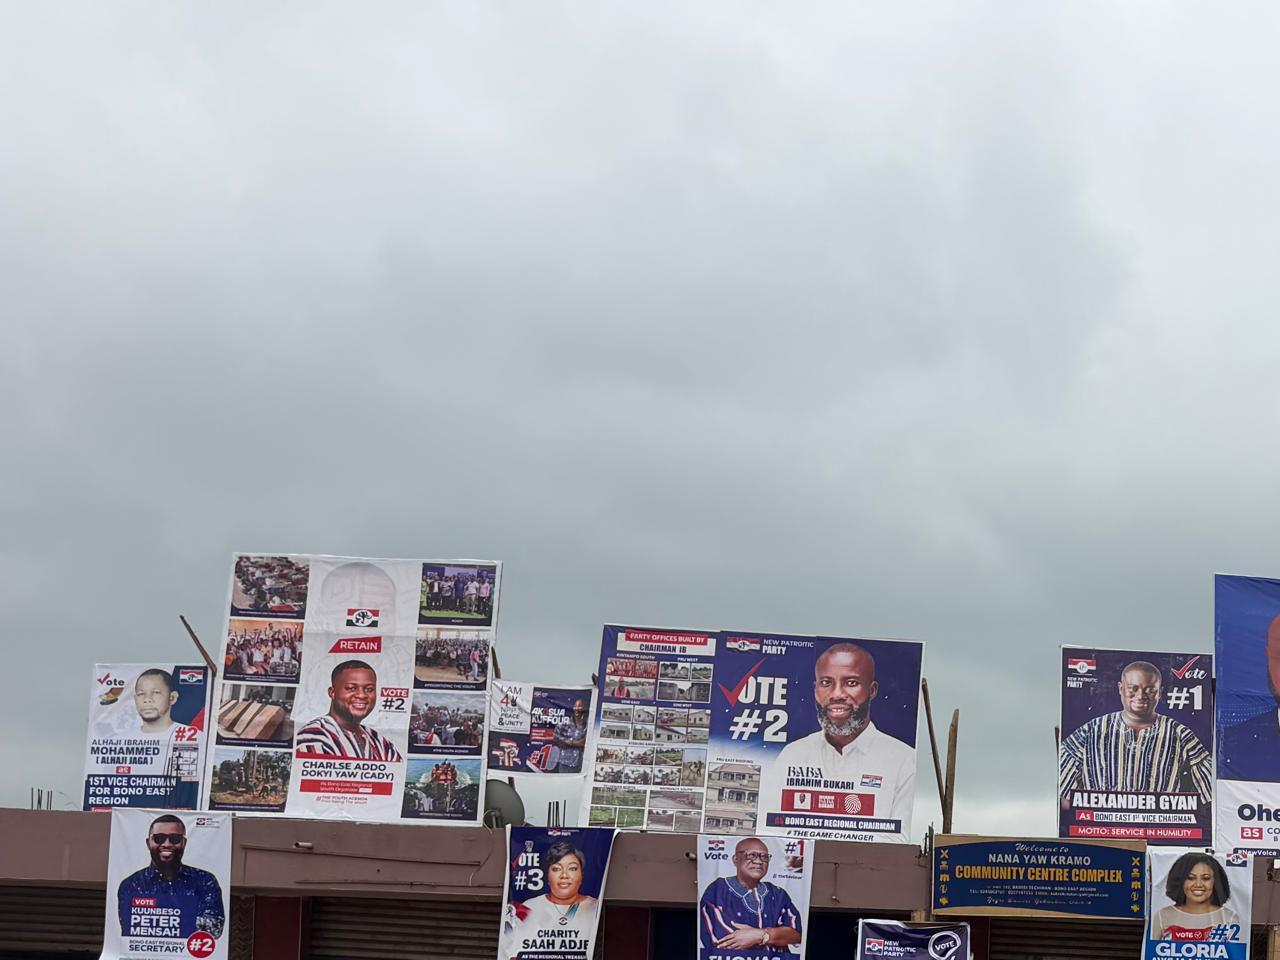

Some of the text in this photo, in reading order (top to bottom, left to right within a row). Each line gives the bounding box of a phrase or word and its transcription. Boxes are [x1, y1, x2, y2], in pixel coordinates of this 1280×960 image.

[340, 642, 377, 651] RETAIN
[639, 644, 676, 654] CHAIRMAN
[762, 646, 786, 655] PARTY
[382, 689, 408, 697] VOTE
[1167, 685, 1202, 710] #1
[382, 698, 406, 712] #2
[729, 709, 788, 743] #2
[175, 726, 198, 742] #2
[90, 747, 160, 756] MOHAMMED
[354, 763, 386, 773] ADDO
[788, 766, 823, 778] BABA
[301, 770, 358, 780] DOKYI YAW
[107, 777, 176, 787] VICE CHAIRMAN
[786, 778, 854, 790] IBRAHIM BUKARI
[89, 787, 173, 796] FOR BONO EAST
[88, 796, 129, 806] REGION
[1072, 792, 1198, 810] ALEXANDER GYAN
[785, 816, 895, 831] BONO EAST REGIONAL CHAIRMAN
[1095, 812, 1192, 824] BONO EAST VICE CHAIRMAN
[1078, 828, 1192, 838] MOTTO: SERVICE HUMILITY
[785, 840, 804, 857] #1
[704, 852, 728, 862] Vote
[988, 853, 1091, 866] NANA YAW KRAMO
[515, 869, 544, 890] #3
[955, 865, 1122, 883] COMMUNITY CENTRE COMPLEX
[135, 898, 154, 906] VOTE
[131, 906, 181, 917] KUUNBESO
[130, 915, 180, 928] PETER
[130, 926, 180, 936] MENSAH
[538, 930, 580, 939] CHARITY
[1210, 924, 1241, 942] #2
[129, 945, 185, 954] SECRETARY
[190, 939, 213, 952] #2
[522, 939, 556, 950] SAAH
[934, 941, 955, 952] VOTE
[1156, 942, 1228, 958] GLORIA
